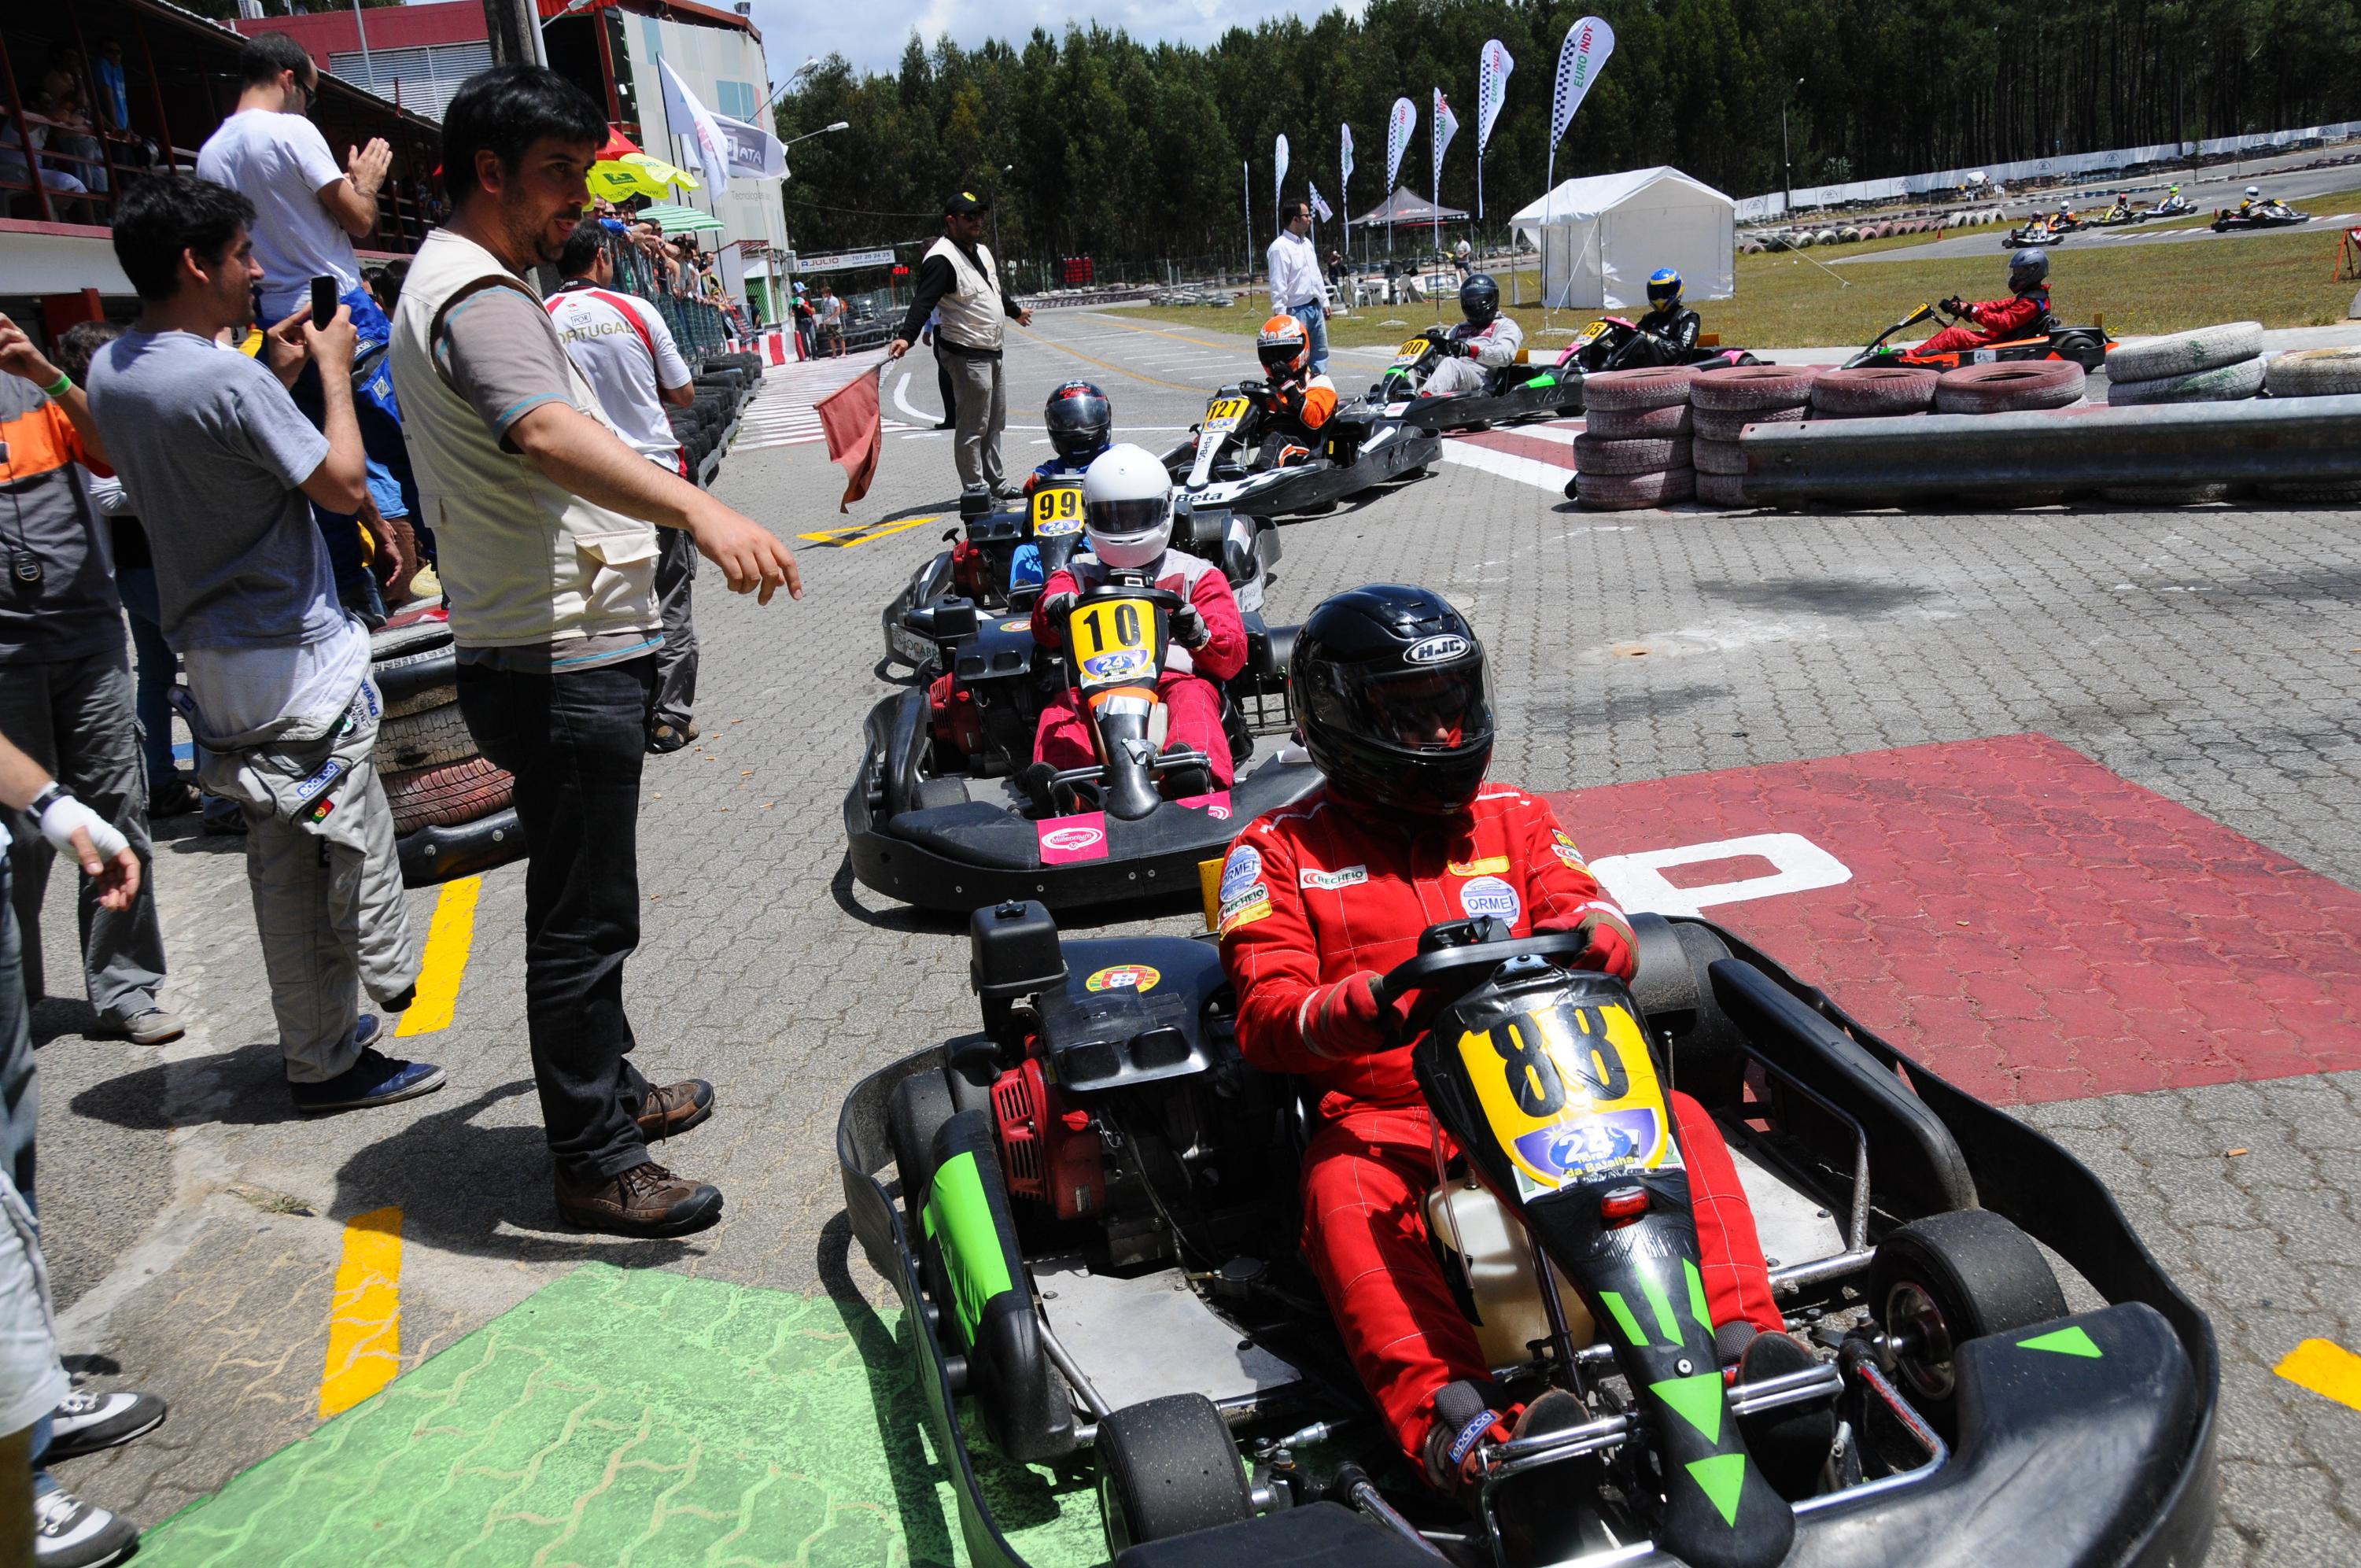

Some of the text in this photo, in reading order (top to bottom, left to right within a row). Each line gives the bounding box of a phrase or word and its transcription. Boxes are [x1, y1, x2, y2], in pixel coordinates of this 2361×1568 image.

[1574, 25, 1593, 88] EURO INDY
[574, 315, 588, 323] POR
[557, 321, 634, 344] ORTUGAL
[1399, 341, 1424, 355] 100
[1208, 400, 1241, 420] 127
[1200, 436, 1214, 456] Beta
[1039, 491, 1076, 520] 99
[1175, 493, 1223, 503] Beta
[1083, 603, 1141, 653] 10
[1418, 639, 1461, 659] HJC
[1101, 655, 1125, 671] 24
[1053, 833, 1092, 843] Millennium
[1317, 871, 1364, 885] RECHEIO
[1489, 1005, 1630, 1118] 88
[1559, 1126, 1616, 1164] 24
[1566, 1166, 1584, 1179] da
[1585, 1156, 1635, 1173] Batalha
